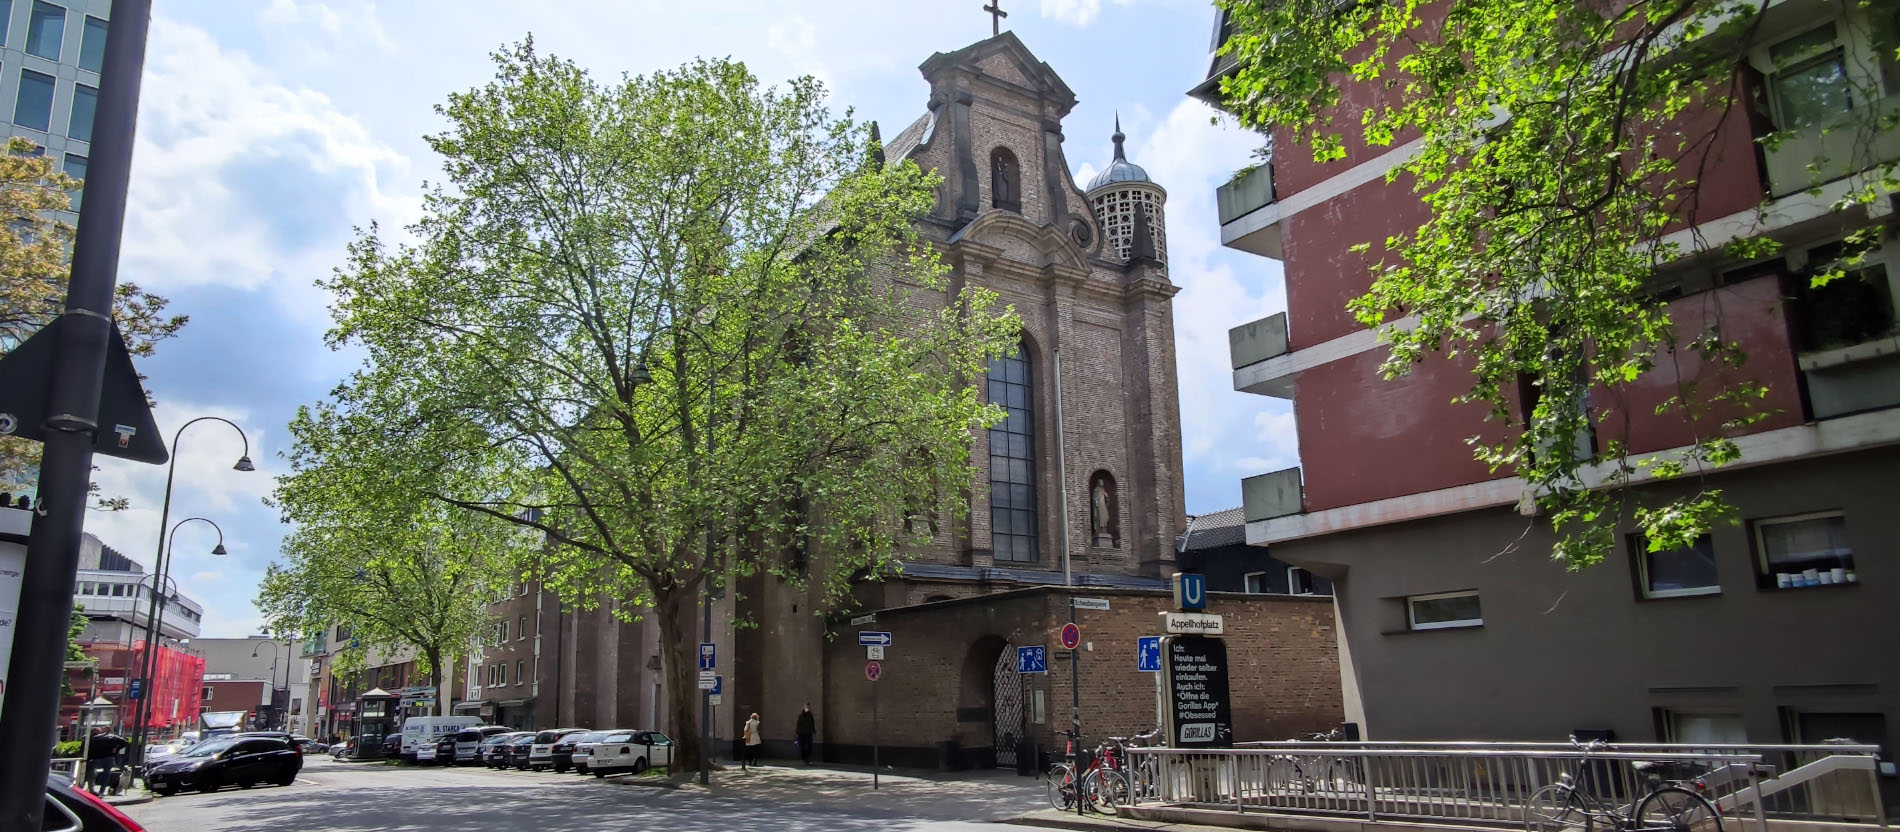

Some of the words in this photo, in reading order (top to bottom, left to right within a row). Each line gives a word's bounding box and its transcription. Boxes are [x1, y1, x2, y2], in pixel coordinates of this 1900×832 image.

[1185, 578, 1200, 604] U
[1171, 618, 1219, 630] Appellhofplatz
[1173, 644, 1185, 652] Ich:
[1174, 654, 1194, 662] Heute
[1194, 654, 1206, 662] mal
[1193, 682, 1206, 690] ich:
[1200, 692, 1210, 700] die
[1178, 702, 1202, 710] Gorillas
[1179, 711, 1216, 719] #Obsessed
[1184, 727, 1212, 738] GORILLAS
